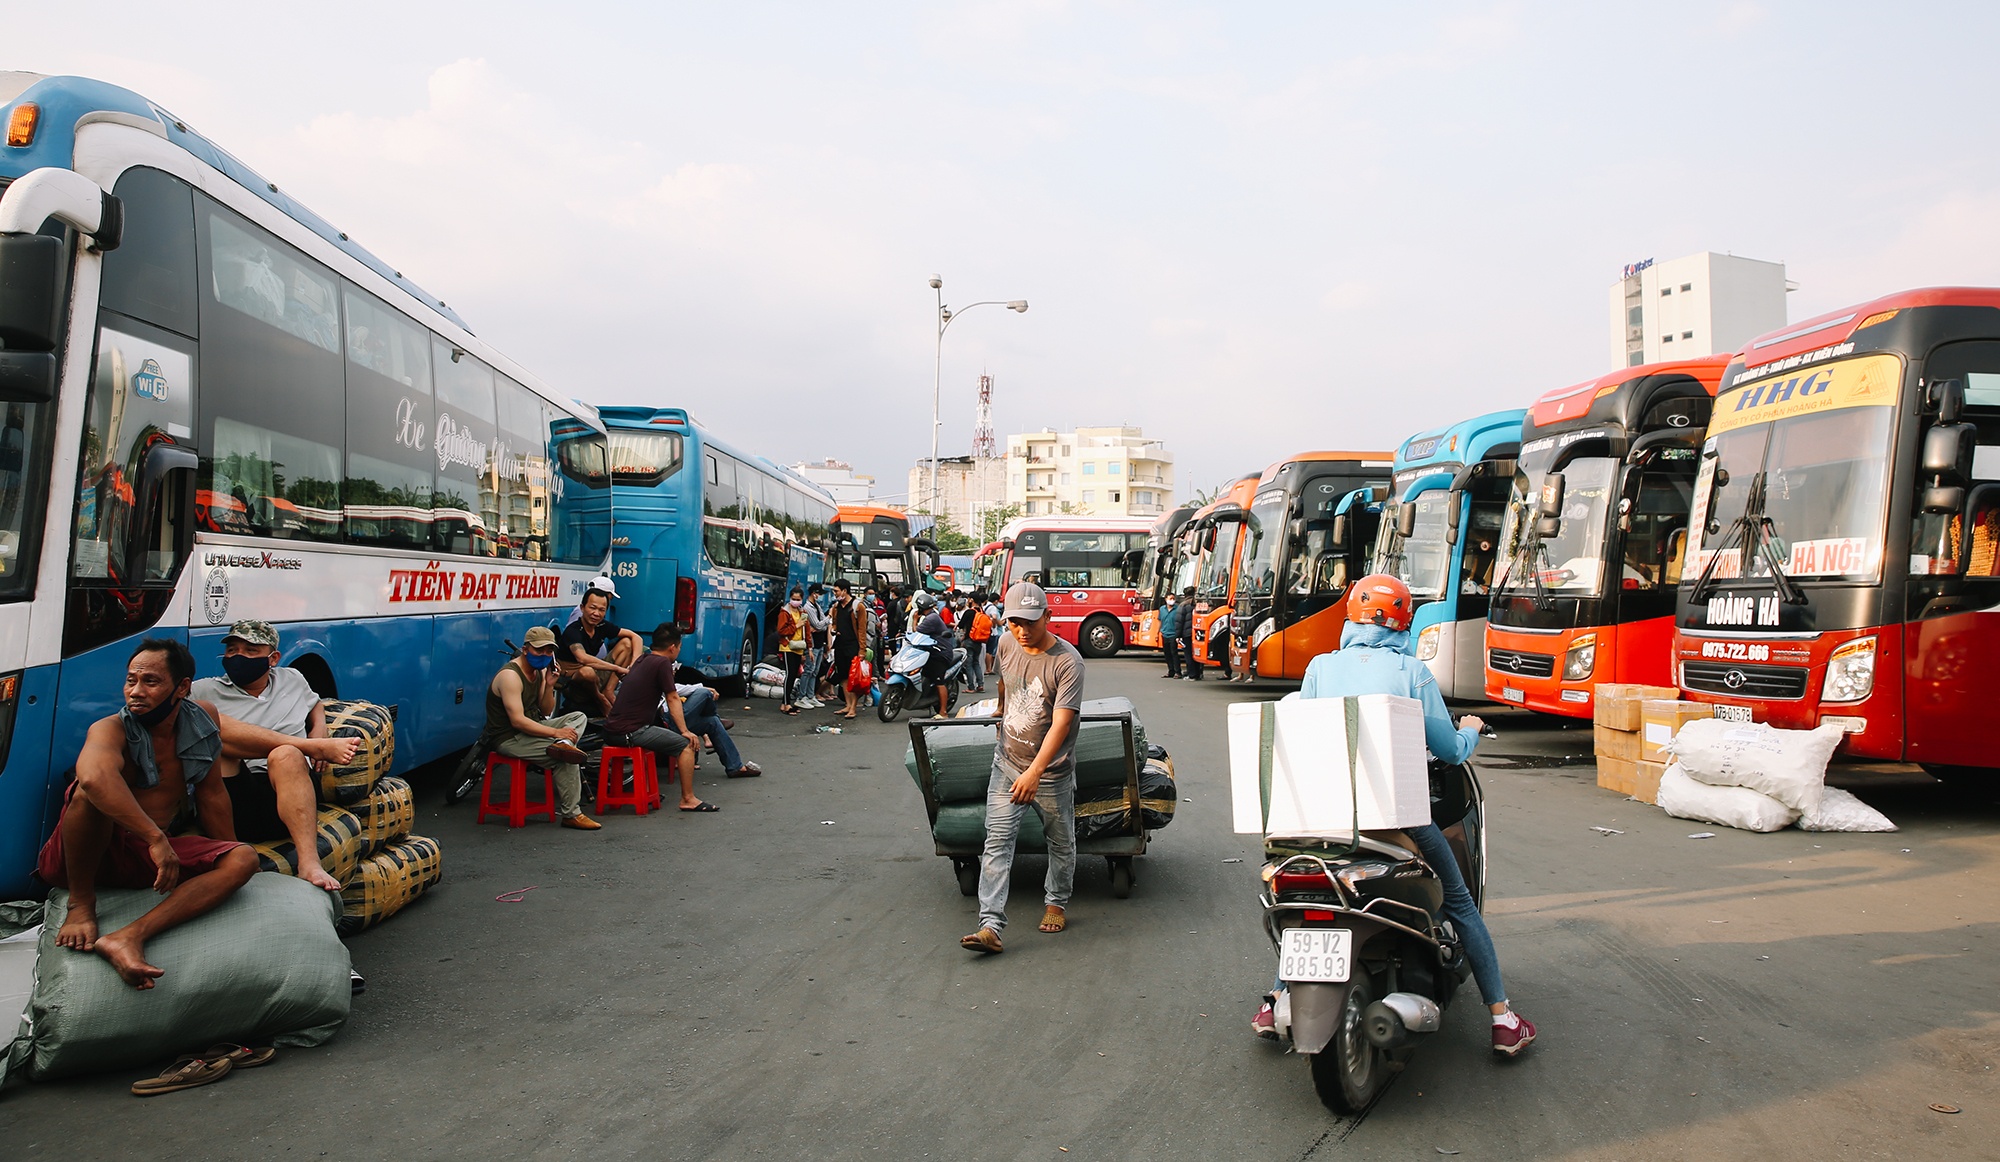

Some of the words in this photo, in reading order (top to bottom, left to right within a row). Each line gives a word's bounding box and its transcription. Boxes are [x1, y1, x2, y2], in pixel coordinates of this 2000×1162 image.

[1733, 367, 1835, 413] HHG
[396, 395, 426, 451] Xe
[1740, 415, 1750, 425] TY
[1412, 440, 1436, 457] VIP
[1793, 541, 1817, 575] HÀ
[388, 560, 457, 603] TIẾN
[458, 571, 502, 609] ĐẠT
[505, 569, 560, 600] THÀNH
[1706, 591, 1754, 626] HOÀNG
[1757, 590, 1780, 626] HÀ
[1702, 641, 1770, 661] 0975.722.666
[1292, 932, 1341, 955] 59-V2
[1285, 956, 1345, 978] 885.93
